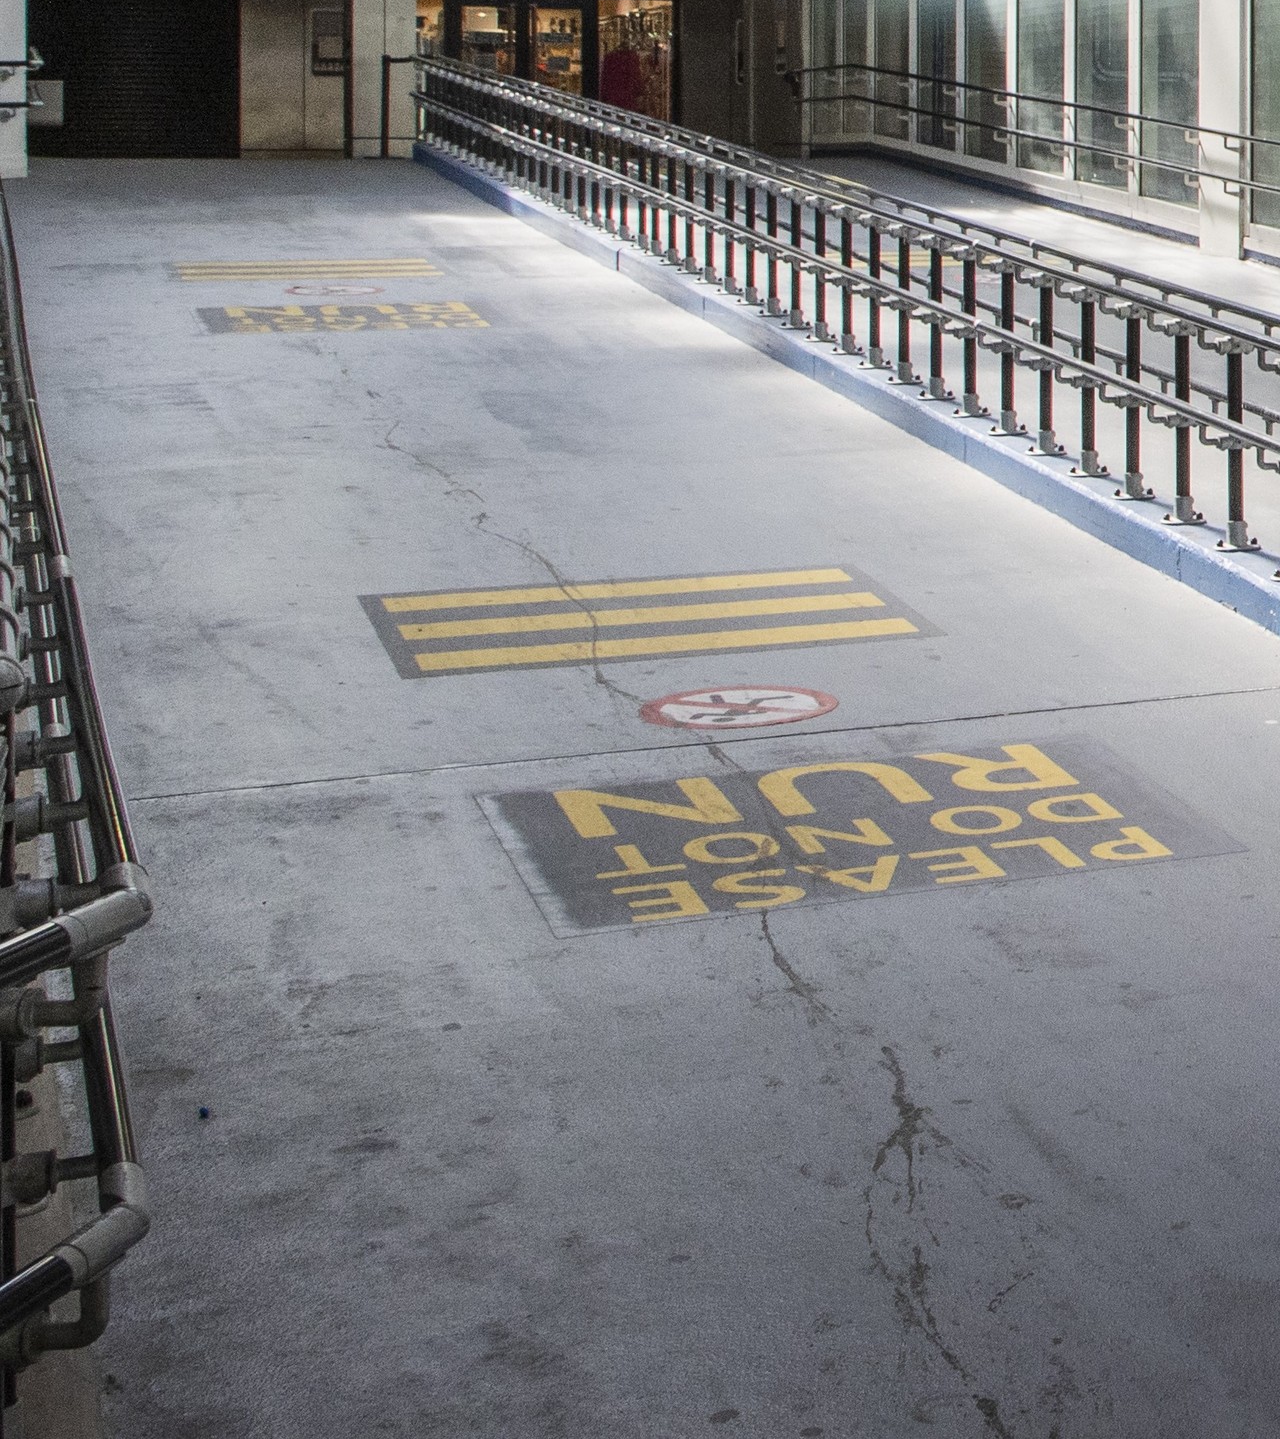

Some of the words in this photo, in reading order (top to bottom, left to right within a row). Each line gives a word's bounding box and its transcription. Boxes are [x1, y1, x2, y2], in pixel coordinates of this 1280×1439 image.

[553, 743, 1080, 839] RUN
[929, 792, 1125, 835] DO
[596, 818, 894, 879] NOT
[611, 825, 1174, 923] PLEASE
